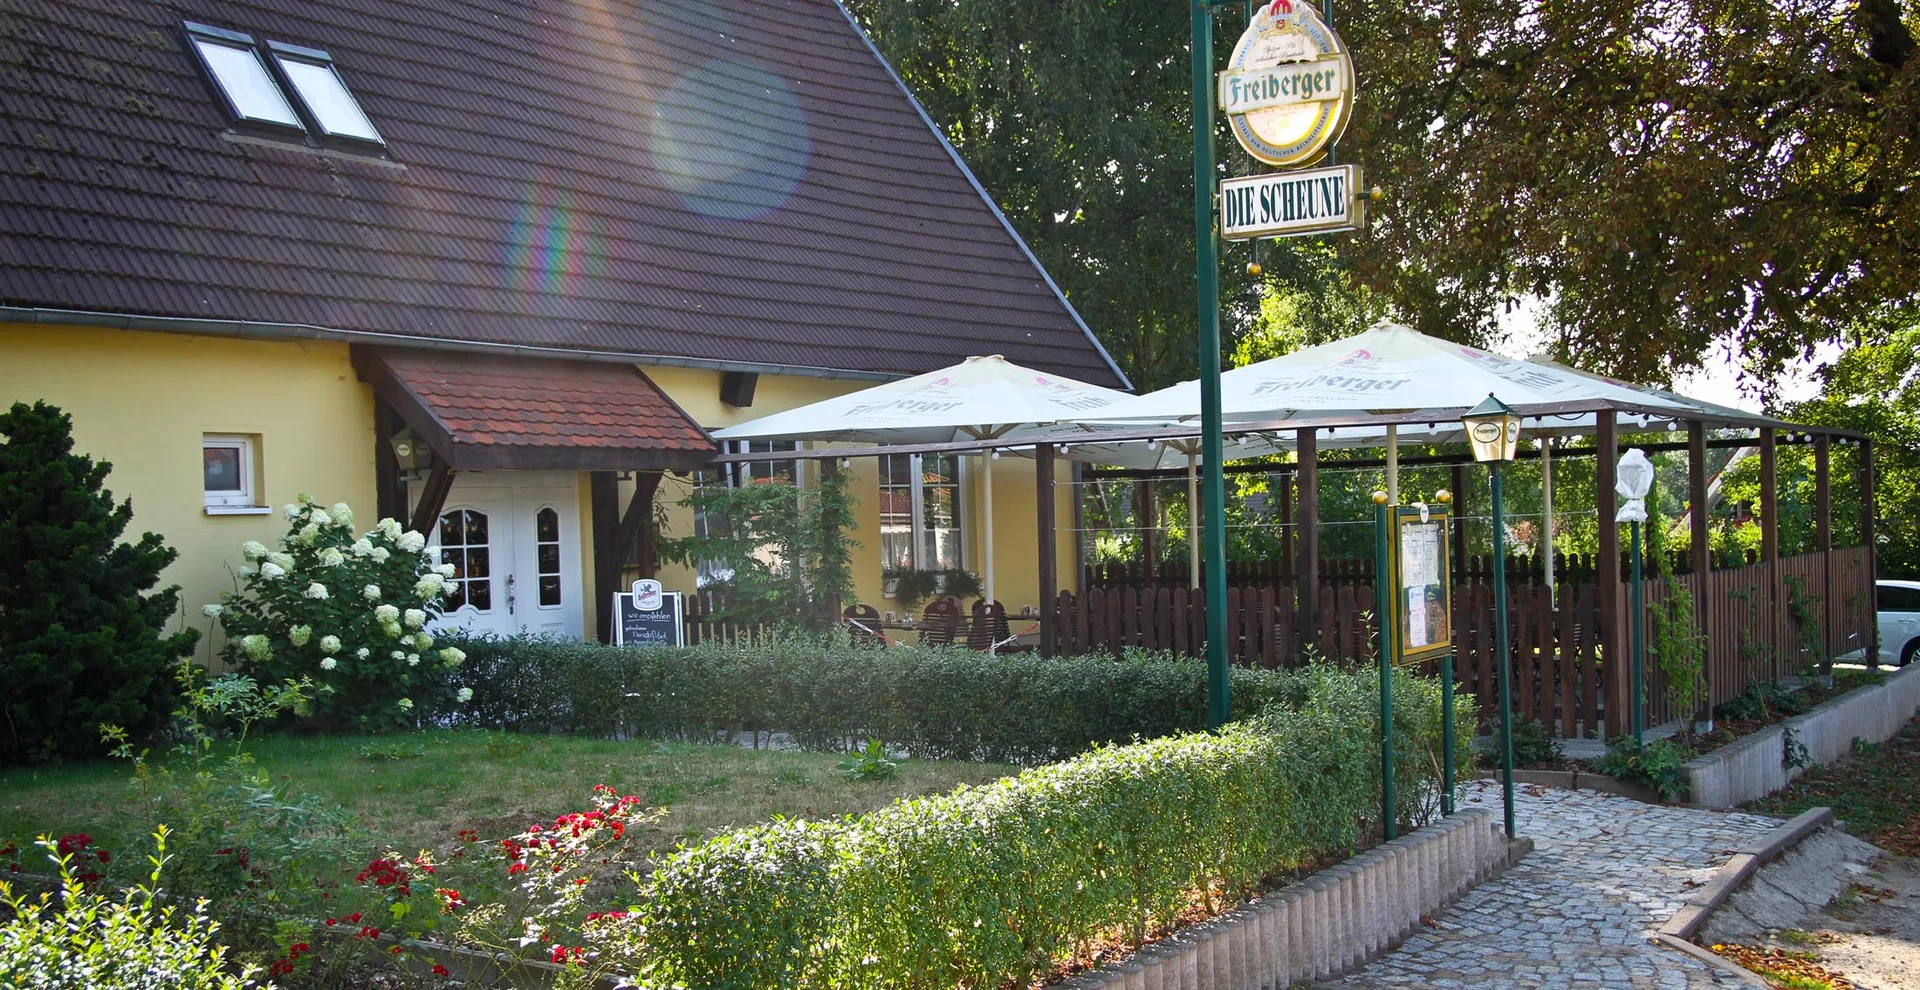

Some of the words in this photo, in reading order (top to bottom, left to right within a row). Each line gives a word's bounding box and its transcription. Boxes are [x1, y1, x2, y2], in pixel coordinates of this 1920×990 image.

[1229, 69, 1336, 107] Freiberger
[1250, 138, 1261, 149] DEM
[1261, 146, 1295, 156] DEUTSCHEN
[1225, 186, 1256, 228] DIE
[1260, 176, 1345, 224] SCHEUNE
[1250, 373, 1411, 396] Freiberger
